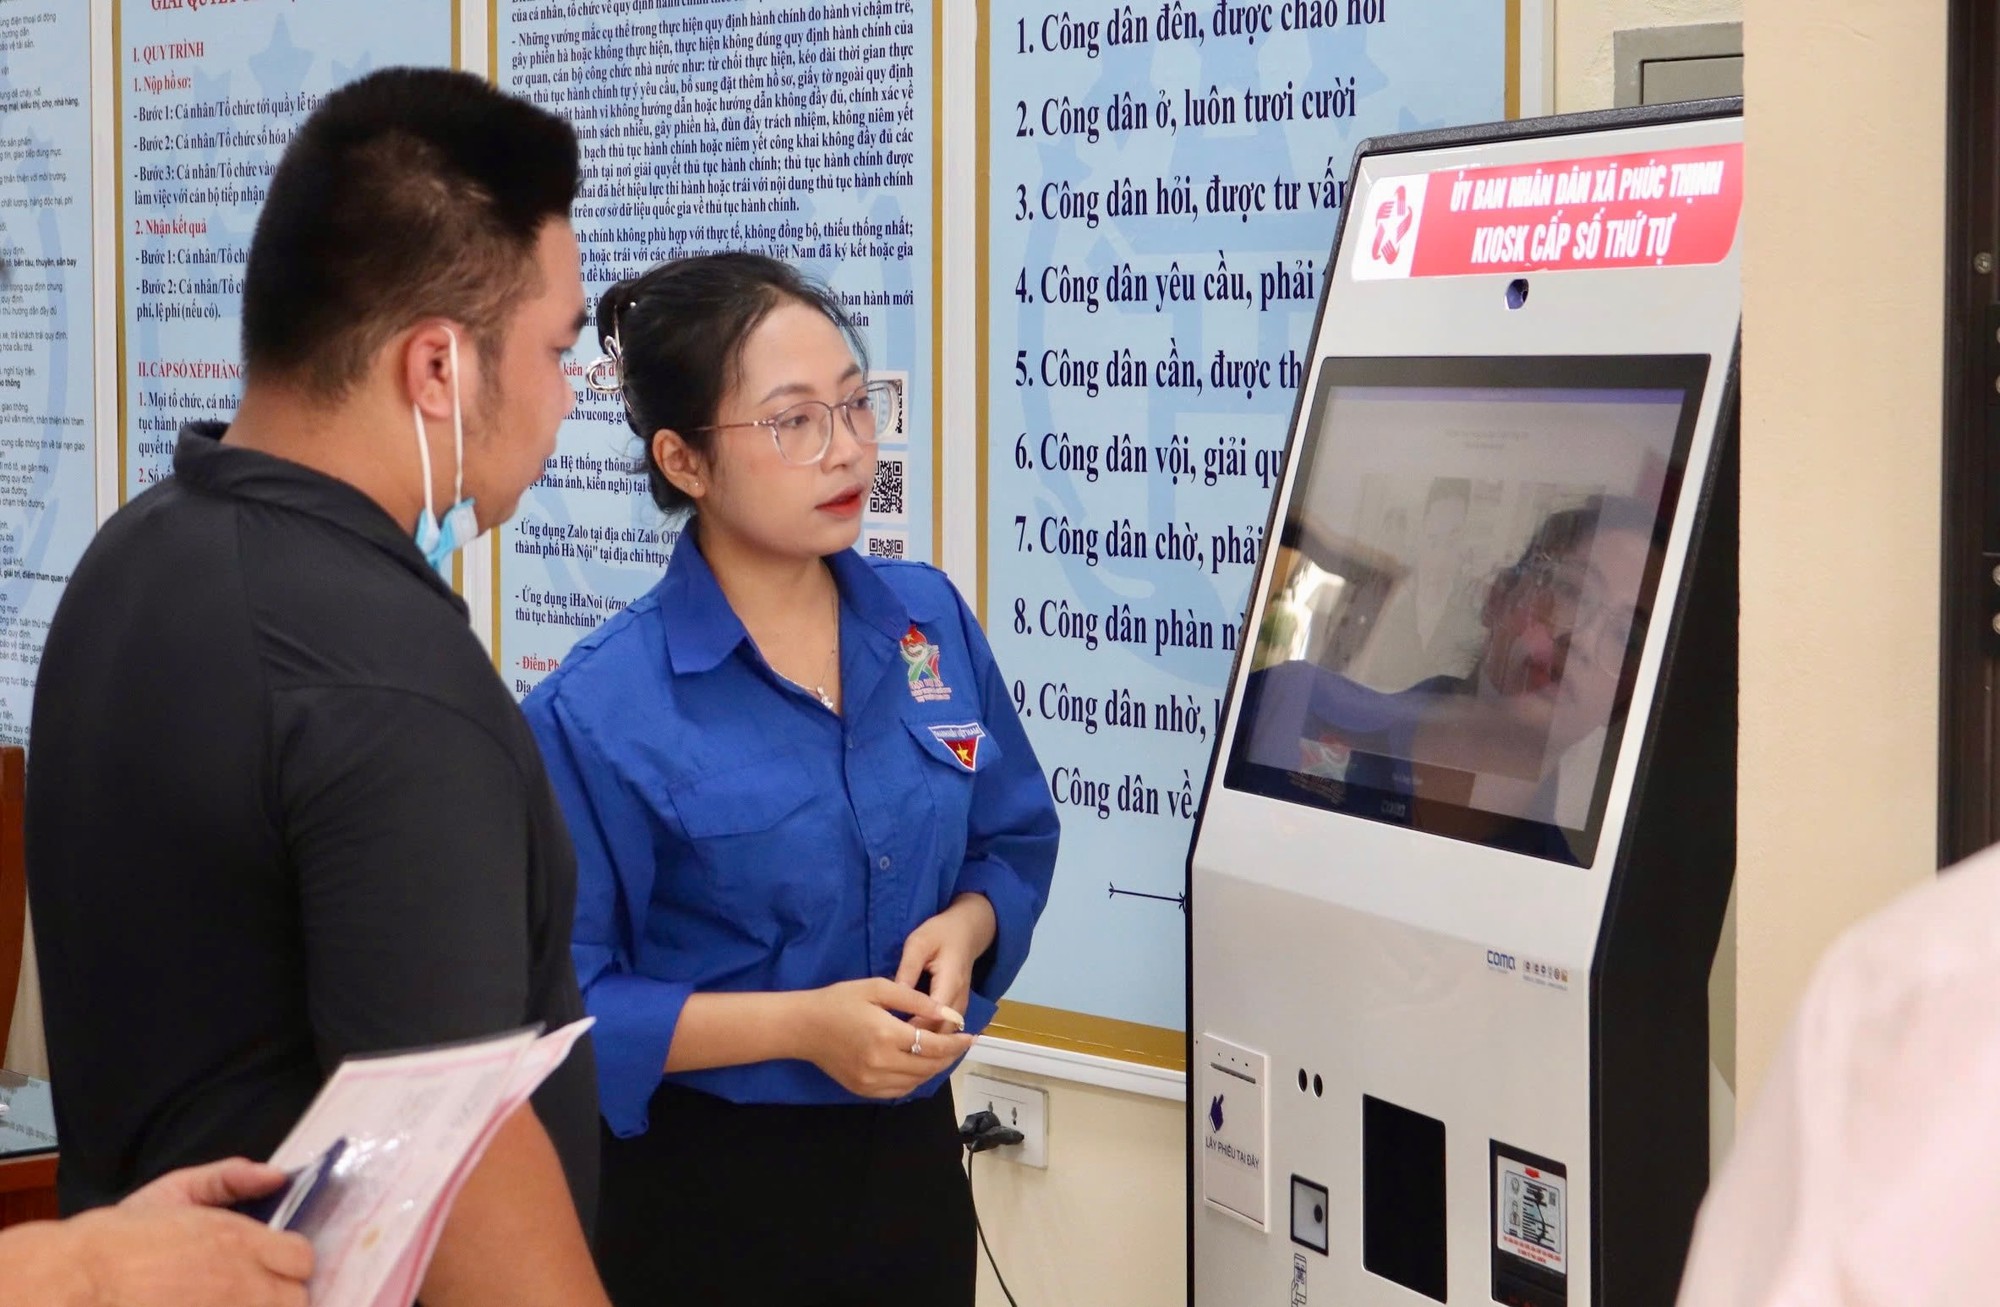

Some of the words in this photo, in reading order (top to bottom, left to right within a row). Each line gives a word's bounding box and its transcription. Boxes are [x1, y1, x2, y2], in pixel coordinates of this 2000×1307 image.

[143, 45, 164, 64] QUY
[168, 41, 203, 59] TRÌNH
[1017, 17, 1033, 54] 1.
[1041, 11, 1099, 58] Công
[1106, 5, 1148, 46] dân
[1212, 0, 1272, 45] được
[134, 77, 141, 92] 1.
[144, 75, 162, 94] Nộp
[177, 77, 190, 88] sơ:
[139, 106, 162, 121] Bước
[165, 105, 172, 120] 1:
[175, 103, 188, 119] Cá
[190, 96, 230, 118] nhân/Tổ
[232, 99, 255, 115] chức
[256, 98, 269, 114] tới
[271, 95, 295, 117] quầy
[1016, 100, 1033, 137] 2.
[1041, 96, 1099, 144] Công
[1106, 91, 1147, 131] dân
[1156, 89, 1176, 135] ở,
[1184, 84, 1235, 126] luôn
[1244, 80, 1293, 122] tươi
[1302, 76, 1355, 119] cười
[139, 135, 163, 151] Bước
[164, 135, 173, 150] 2:
[175, 133, 189, 149] Cá
[190, 127, 230, 148] nhân/Tổ
[232, 130, 255, 146] chức
[268, 128, 286, 144] hóa
[134, 190, 151, 204] làm
[153, 188, 171, 208] việc
[172, 188, 187, 203] với
[189, 187, 205, 203] cán
[207, 186, 219, 206] bộ
[221, 185, 238, 206] tiếp
[240, 185, 265, 206] nhận
[597, 183, 608, 197] đã
[610, 179, 624, 196] hết
[627, 181, 646, 199] hiệu
[649, 182, 664, 199] lực
[666, 180, 678, 194] thi
[681, 179, 705, 194] hành
[707, 179, 730, 196] hoặc
[732, 177, 750, 192] trái
[752, 176, 767, 191] với
[770, 175, 785, 194] nội
[788, 175, 814, 193] dung
[816, 174, 833, 189] thủ
[836, 176, 852, 192] tục
[854, 172, 880, 187] hành
[883, 170, 912, 186] chính
[1015, 183, 1033, 220] 3.
[1041, 180, 1099, 228] Công
[1106, 177, 1147, 217] dân
[1156, 175, 1198, 222] hỏi,
[1206, 174, 1265, 223] được
[1273, 175, 1300, 210] tư
[1450, 169, 1473, 212] ỦY
[1472, 177, 1508, 211] BAN
[1507, 167, 1555, 209] NHÂN
[1554, 165, 1593, 206] DÂN
[1591, 162, 1618, 203] XÃ
[1618, 158, 1668, 201] PHÚC
[135, 219, 143, 234] 2.
[146, 219, 170, 238] Nhận
[172, 214, 186, 234] kết
[188, 218, 206, 238] quả
[588, 228, 614, 242] chính
[616, 227, 646, 245] không
[648, 226, 666, 245] phù
[668, 226, 687, 247] hợp
[689, 225, 704, 240] với
[706, 225, 728, 243] thực
[730, 220, 742, 240] tế,
[744, 223, 776, 244] không
[778, 219, 803, 241] đồng
[805, 222, 821, 240] bộ,
[823, 217, 849, 236] thiếu
[852, 217, 882, 241] thống
[885, 216, 912, 236] nhất;
[1470, 224, 1530, 264] KIOSK
[1530, 208, 1572, 262] CẤP
[1572, 206, 1606, 261] SỐ
[1604, 210, 1648, 259] THỨ
[1645, 212, 1678, 267] TỰ
[1015, 266, 1033, 303] 4.
[1040, 264, 1098, 313] Công
[1106, 262, 1147, 302] dân
[1155, 261, 1195, 312] yêu
[1204, 249, 1252, 308] cầu,
[1260, 259, 1314, 311] phải
[136, 302, 154, 321] phí,
[155, 302, 163, 321] lệ
[164, 302, 180, 322] phí
[181, 298, 202, 320] (nếu
[204, 302, 220, 320] có).
[1015, 350, 1033, 386] 5.
[1040, 348, 1098, 397] Công
[1106, 348, 1147, 387] dân
[1155, 337, 1202, 396] cần,
[1210, 349, 1270, 399] được
[1015, 432, 1032, 469] 6.
[1040, 432, 1098, 482] Công
[1106, 433, 1147, 472] dân
[1155, 434, 1196, 485] vội,
[1204, 436, 1246, 486] giải
[521, 518, 540, 539] Ứng
[542, 522, 565, 541] dụng
[567, 524, 588, 538] Zalo
[590, 526, 602, 543] tại
[604, 526, 618, 544] địa
[621, 528, 635, 542] chỉ
[637, 528, 658, 544] Zalo
[1014, 515, 1032, 552] 7.
[1040, 516, 1098, 566] Công
[1105, 518, 1147, 558] dân
[1155, 522, 1203, 570] chờ,
[522, 585, 541, 606] Ứng
[544, 591, 567, 609] dụng
[569, 592, 602, 609] iHaNoi
[1014, 597, 1031, 634] 8.
[1040, 599, 1098, 650] Công
[1105, 603, 1146, 643] dân
[1154, 608, 1213, 656] phàn
[1013, 680, 1031, 718] 9.
[1039, 682, 1097, 734] Công
[1105, 688, 1146, 728] dân
[1154, 694, 1206, 743] nhờ,
[1052, 766, 1110, 819] Công
[1117, 774, 1158, 815] dân
